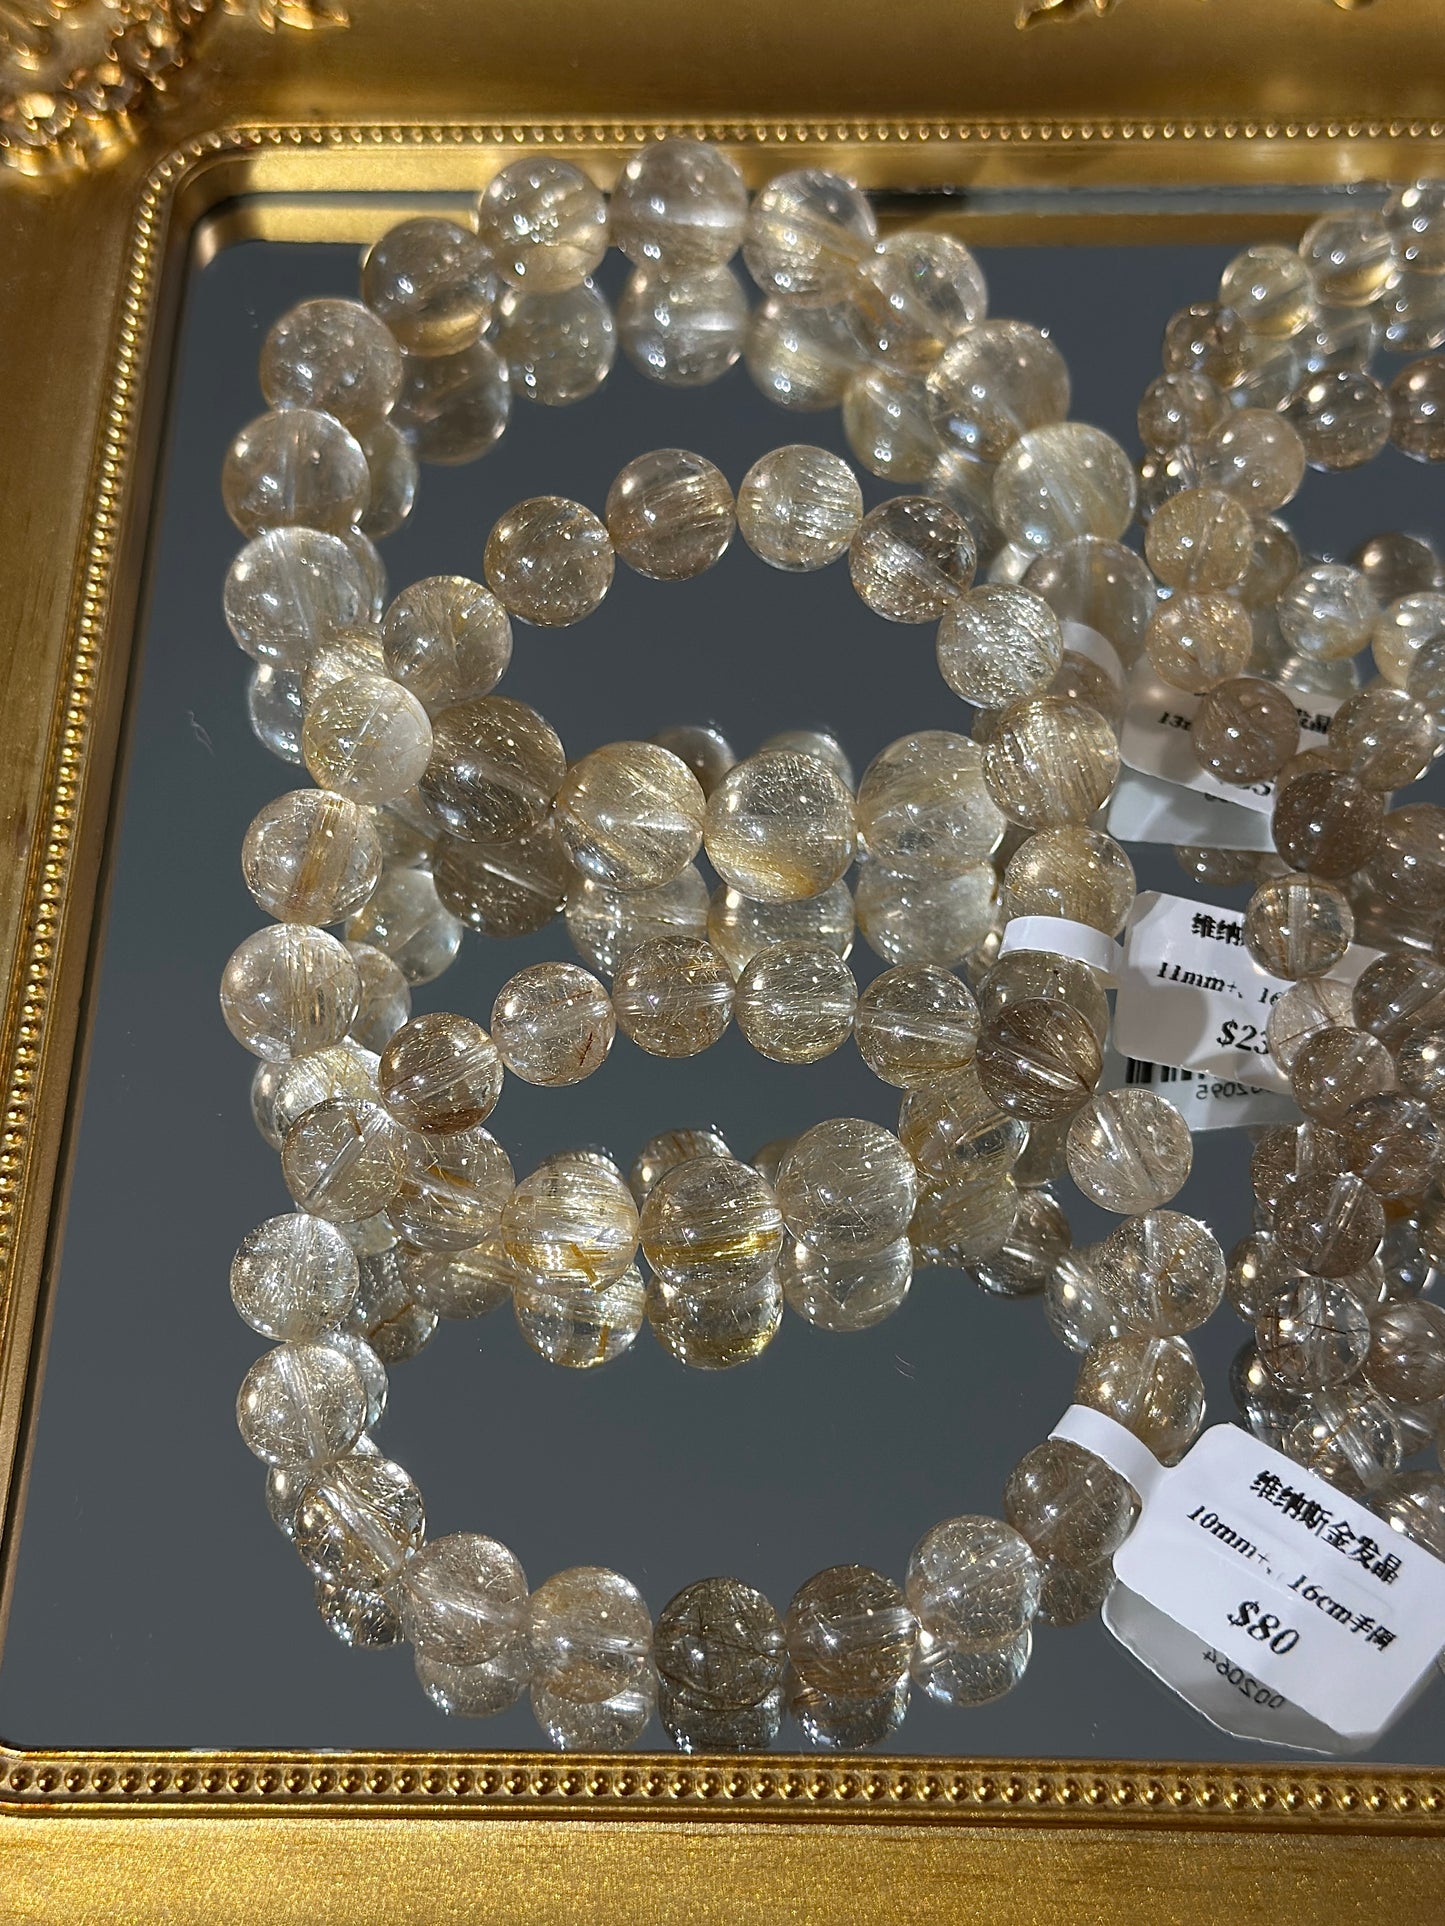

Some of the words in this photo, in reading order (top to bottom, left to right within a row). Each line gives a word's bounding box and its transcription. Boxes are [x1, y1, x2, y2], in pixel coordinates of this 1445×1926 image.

[1191, 913, 1244, 946] 维纳
[1249, 1470, 1402, 1585] 维纳斯金发晶
[1227, 1600, 1300, 1655] $80
